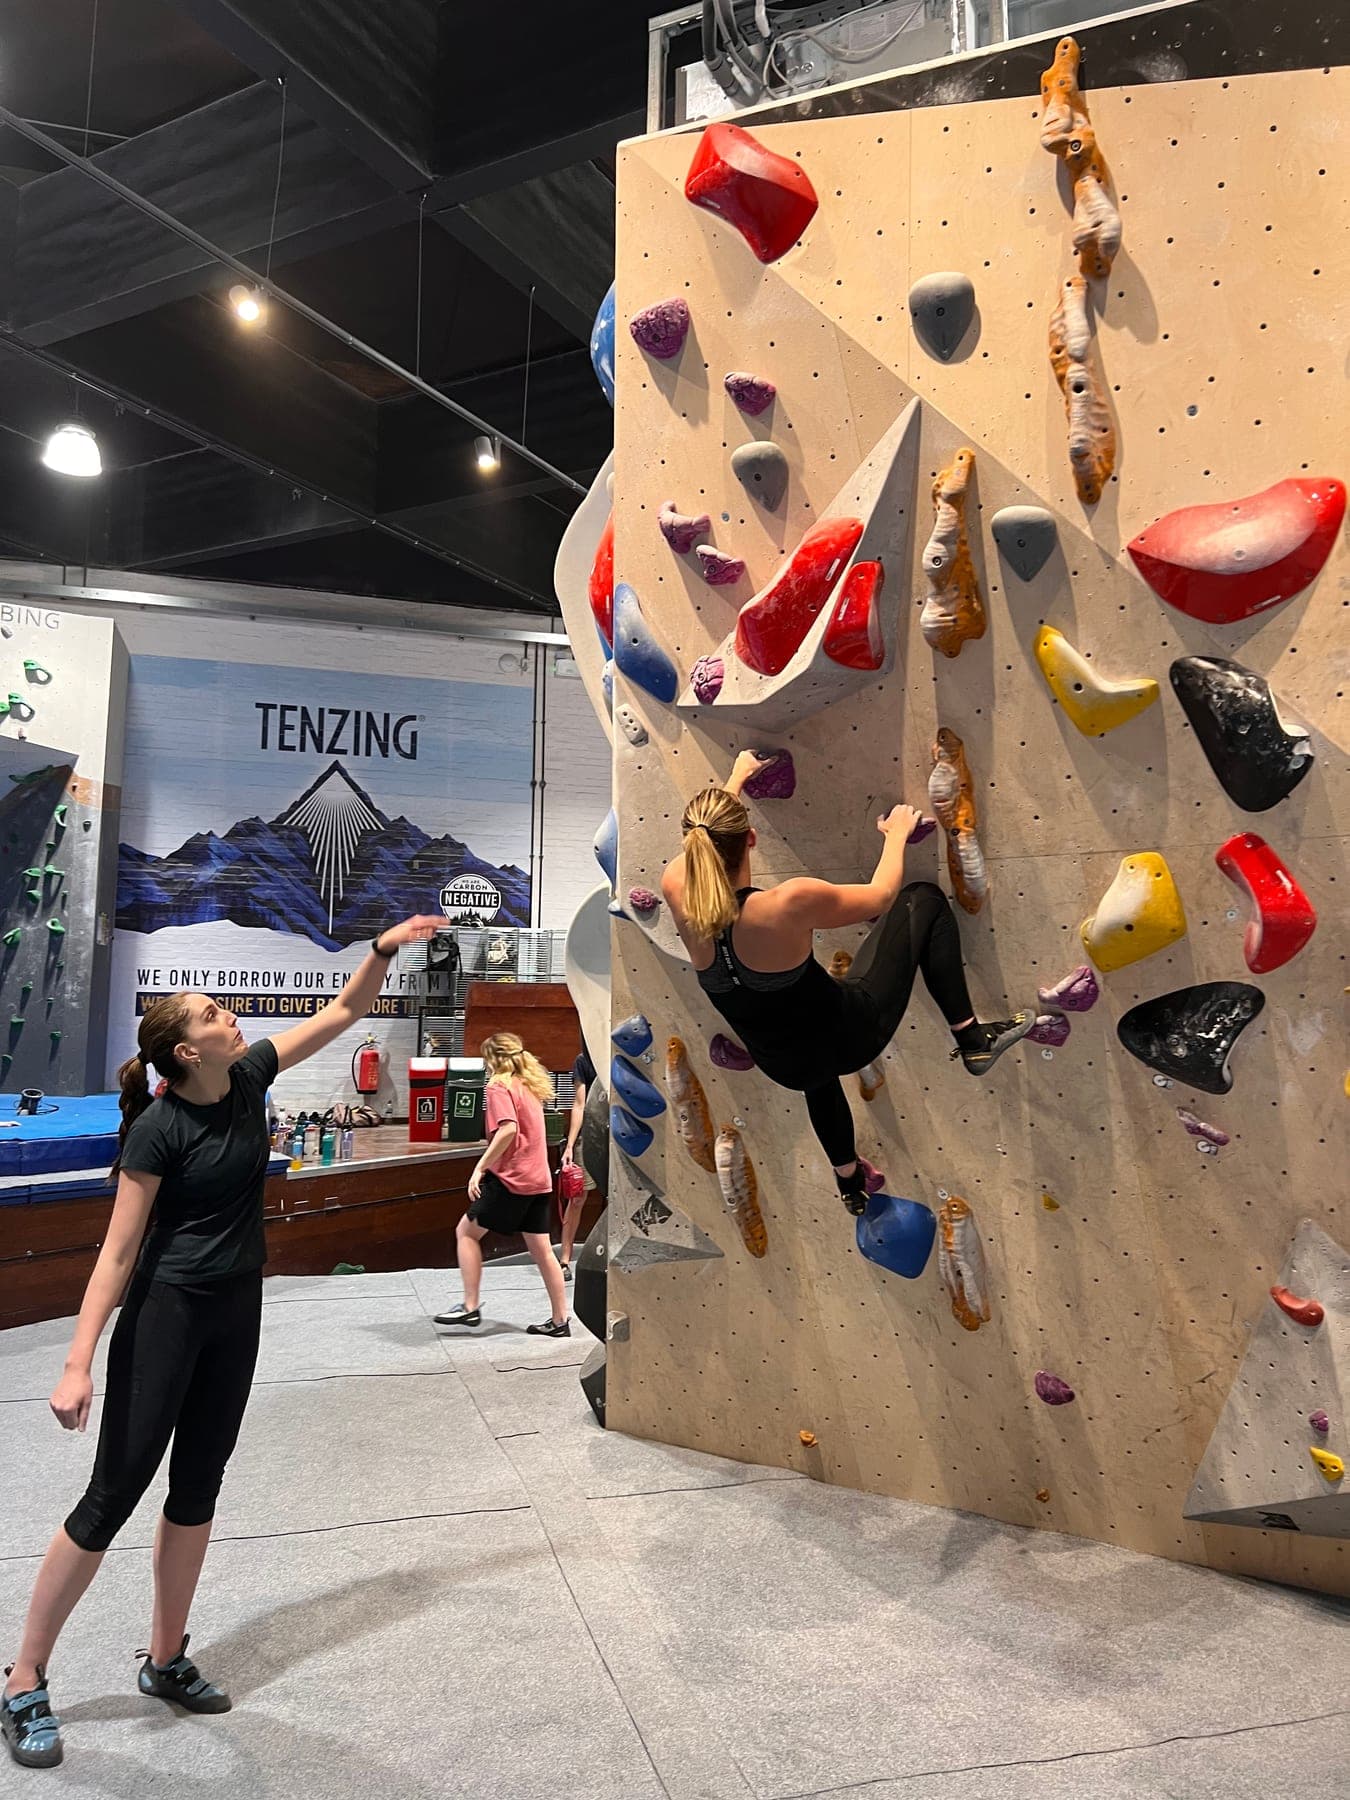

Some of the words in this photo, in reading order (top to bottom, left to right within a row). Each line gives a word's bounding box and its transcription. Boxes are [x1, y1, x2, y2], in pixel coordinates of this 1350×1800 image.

[1, 605, 60, 629] BING
[445, 892, 498, 906] NEGATIVE
[137, 969, 161, 985] WE
[170, 969, 210, 986] ONLY
[217, 970, 286, 987] BORROW
[294, 972, 324, 988] OUR
[332, 972, 392, 989] ENY
[215, 996, 254, 1013] SURE
[256, 997, 277, 1013] TO
[280, 997, 313, 1013] GIVE
